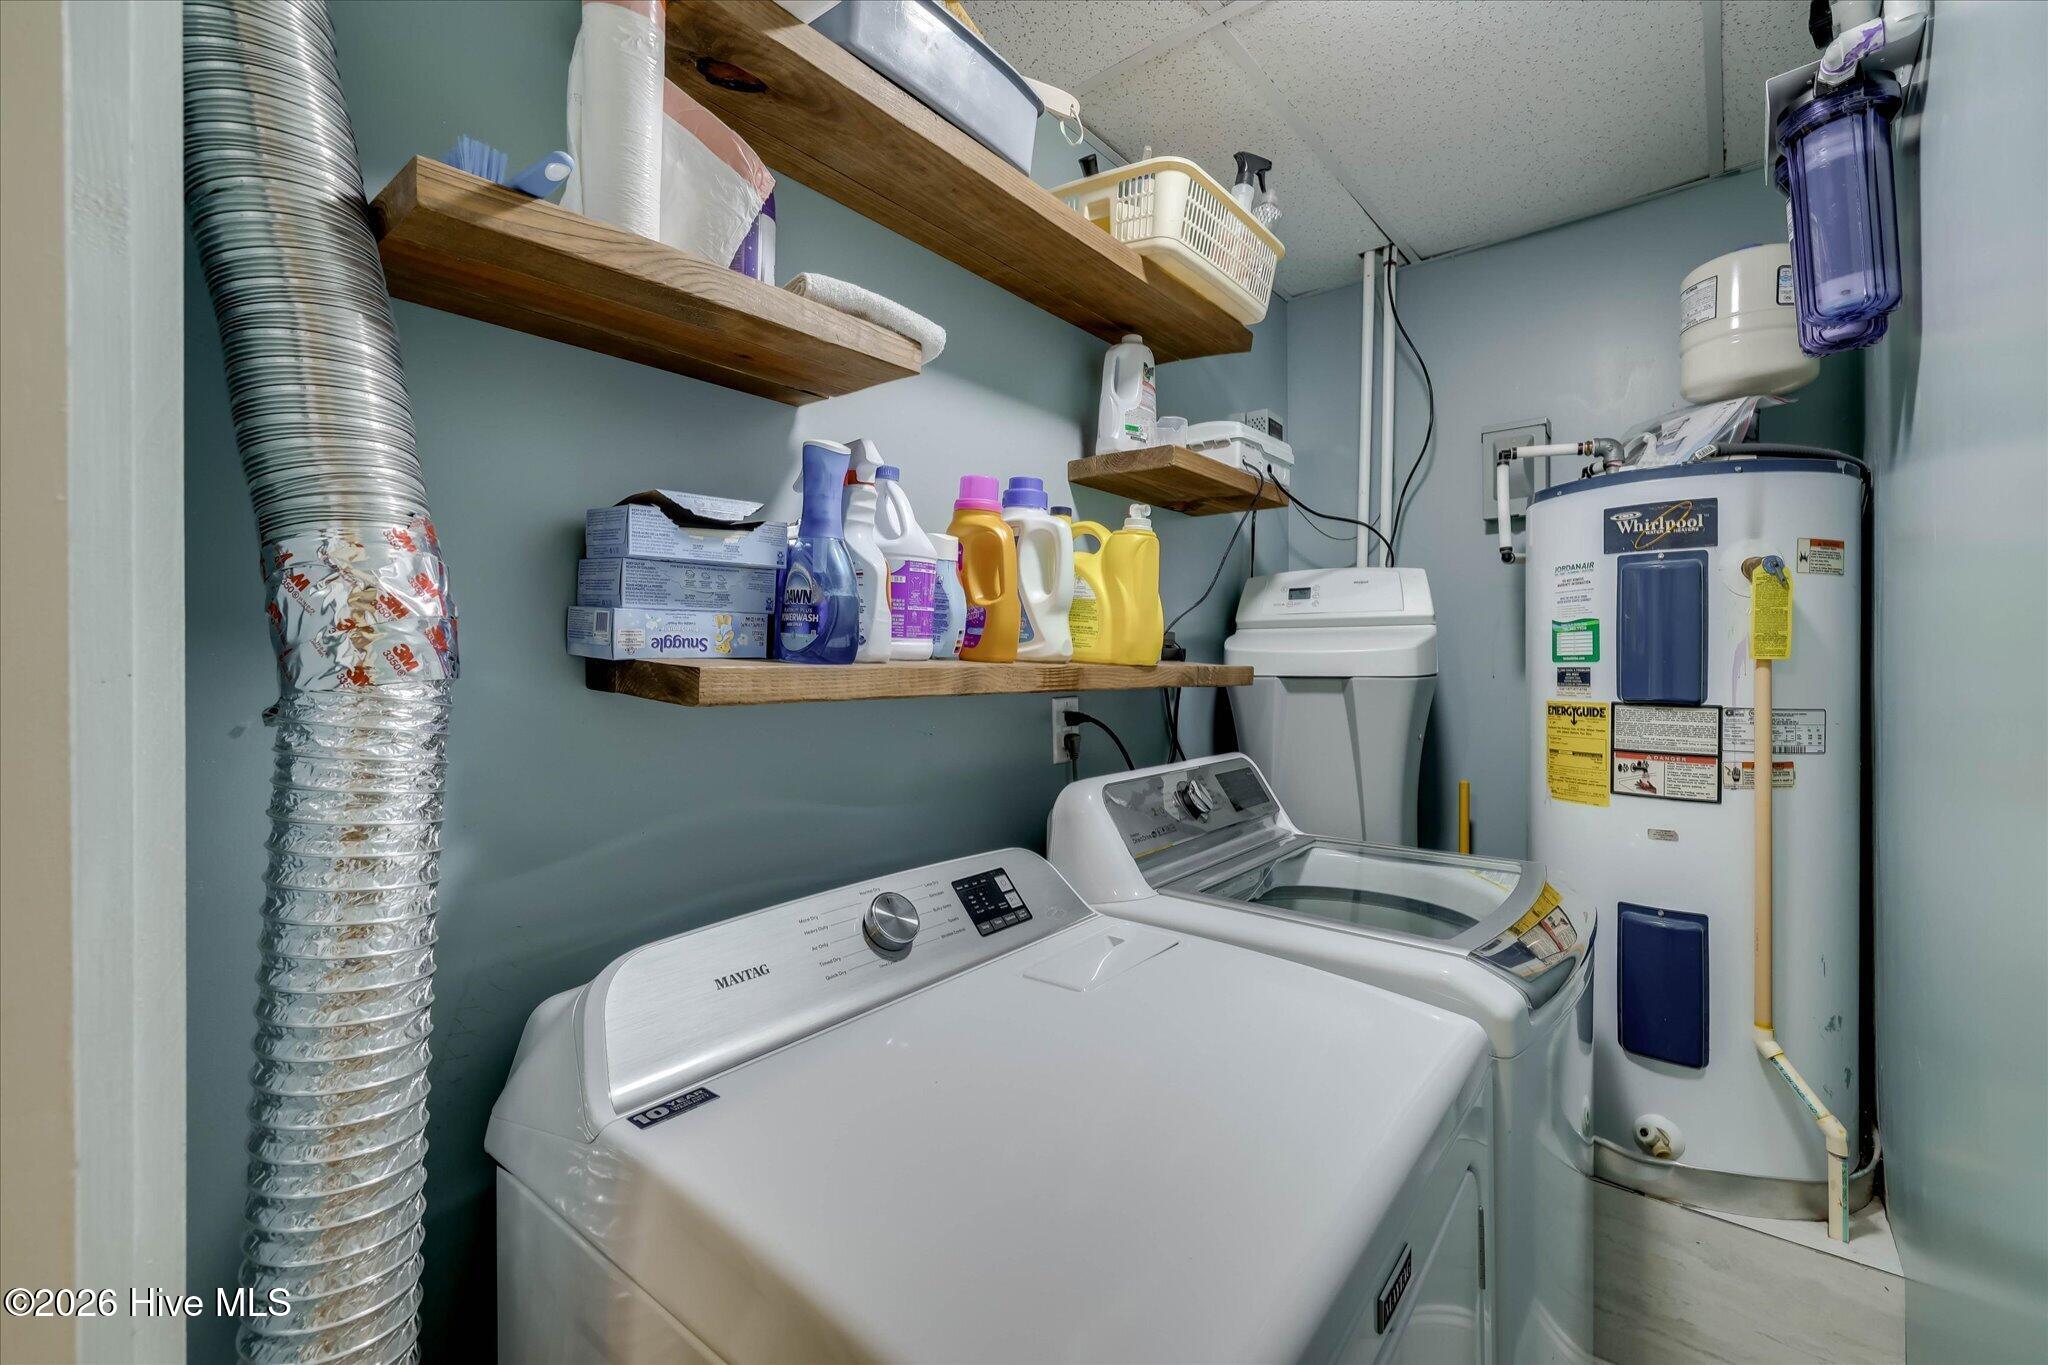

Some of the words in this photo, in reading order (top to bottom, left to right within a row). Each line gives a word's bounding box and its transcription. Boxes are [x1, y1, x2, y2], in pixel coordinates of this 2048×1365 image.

[1616, 513, 1704, 534] Whirlpool
[651, 634, 708, 653] Snuggle
[393, 643, 419, 672] 3M
[1548, 705, 1606, 720] ENERGYGUIDE
[1653, 756, 1687, 764] DANGER
[714, 963, 770, 990] MAYTAG
[633, 1107, 670, 1124] 10
